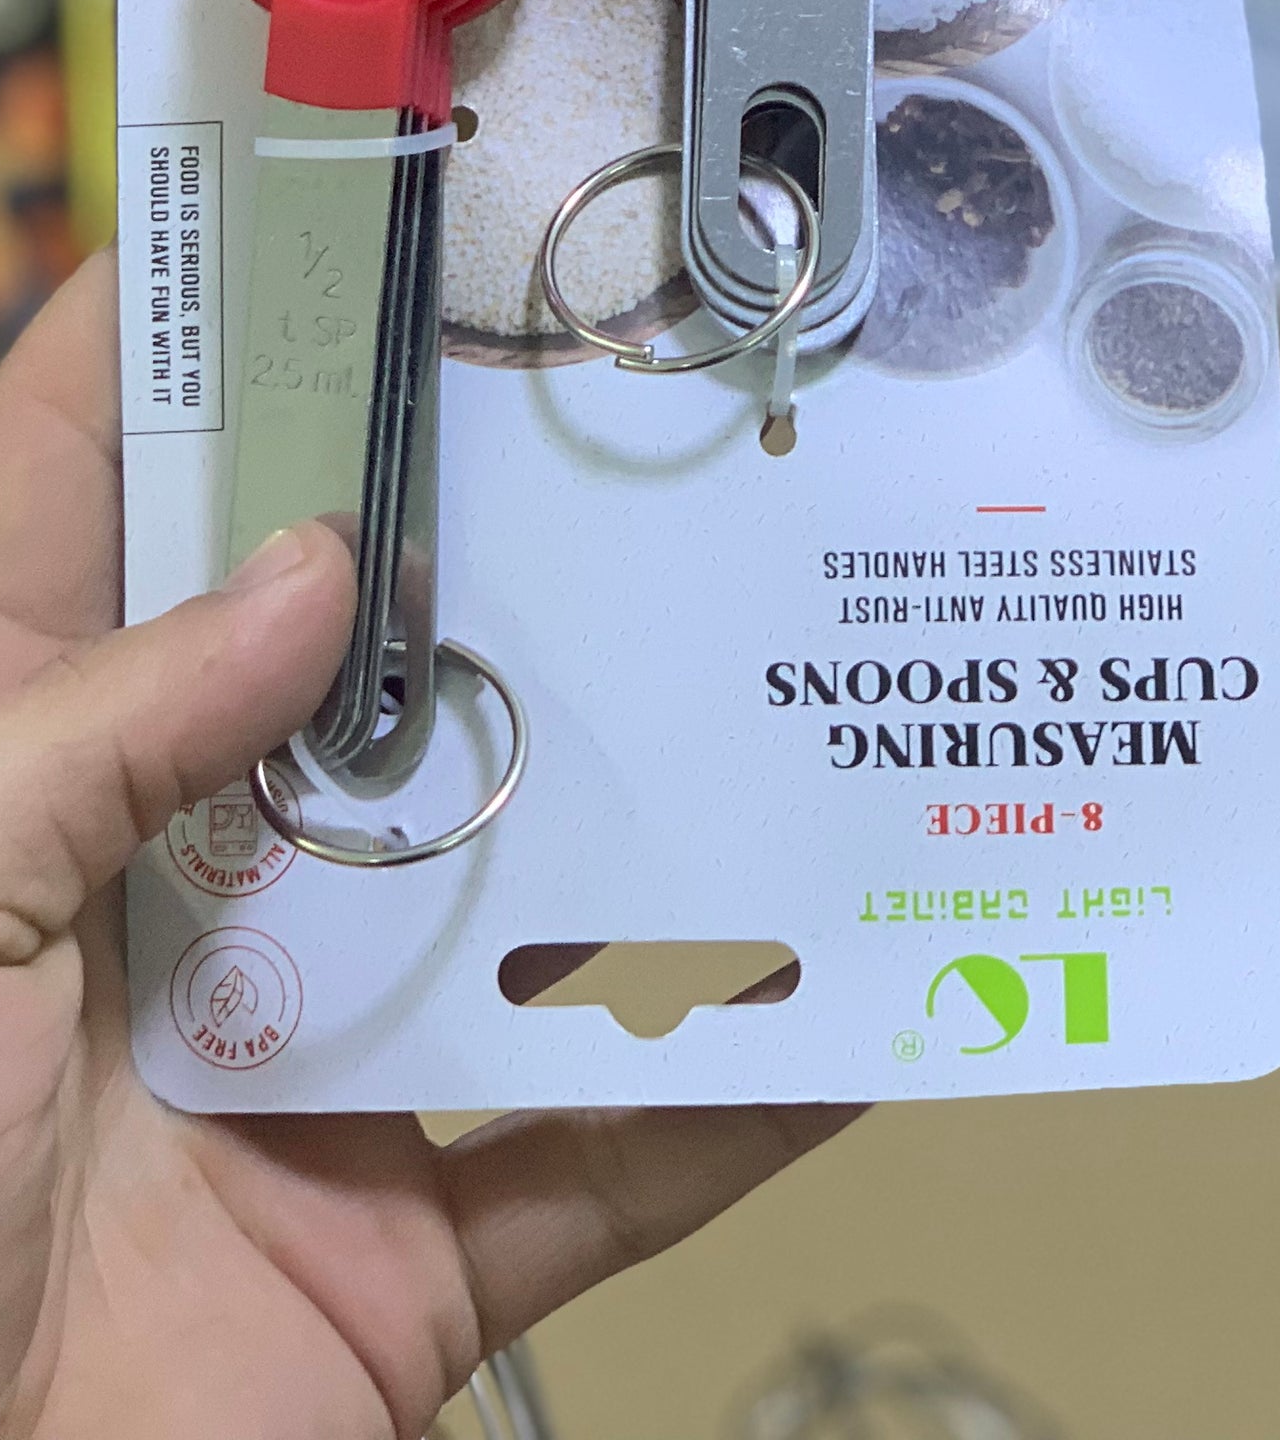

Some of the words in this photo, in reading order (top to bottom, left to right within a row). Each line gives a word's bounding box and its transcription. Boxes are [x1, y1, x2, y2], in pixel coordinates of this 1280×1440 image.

[150, 147, 170, 222] SHOULD
[180, 145, 199, 195] FOOD
[180, 204, 199, 221] IS
[151, 230, 170, 278] HAVE
[178, 229, 200, 318] SERIOUS,
[151, 286, 170, 323] FUN
[152, 331, 171, 380] WITH
[181, 325, 200, 361] BUT
[152, 388, 171, 405] IT
[181, 369, 201, 407] YOU
[821, 551, 946, 579] HANDLES
[957, 550, 1039, 578] STEEL
[1048, 549, 1197, 577] STAINLESS
[837, 595, 985, 624] ANTI-RUST
[996, 592, 1106, 622] QUALITY
[1119, 593, 1183, 621] HIGH
[764, 658, 1018, 707] SPOONS
[1036, 657, 1080, 703] &
[1098, 656, 1260, 703] CUPS
[826, 720, 1203, 770] MEASURING
[925, 802, 1104, 836] 8-PIECE
[180, 843, 261, 888] MATERIALS
[259, 843, 287, 870] ALL
[858, 889, 1029, 922] CABINET
[1056, 886, 1173, 918] LIGHT
[192, 1024, 237, 1060] FREE
[243, 1024, 280, 1058] BPA
